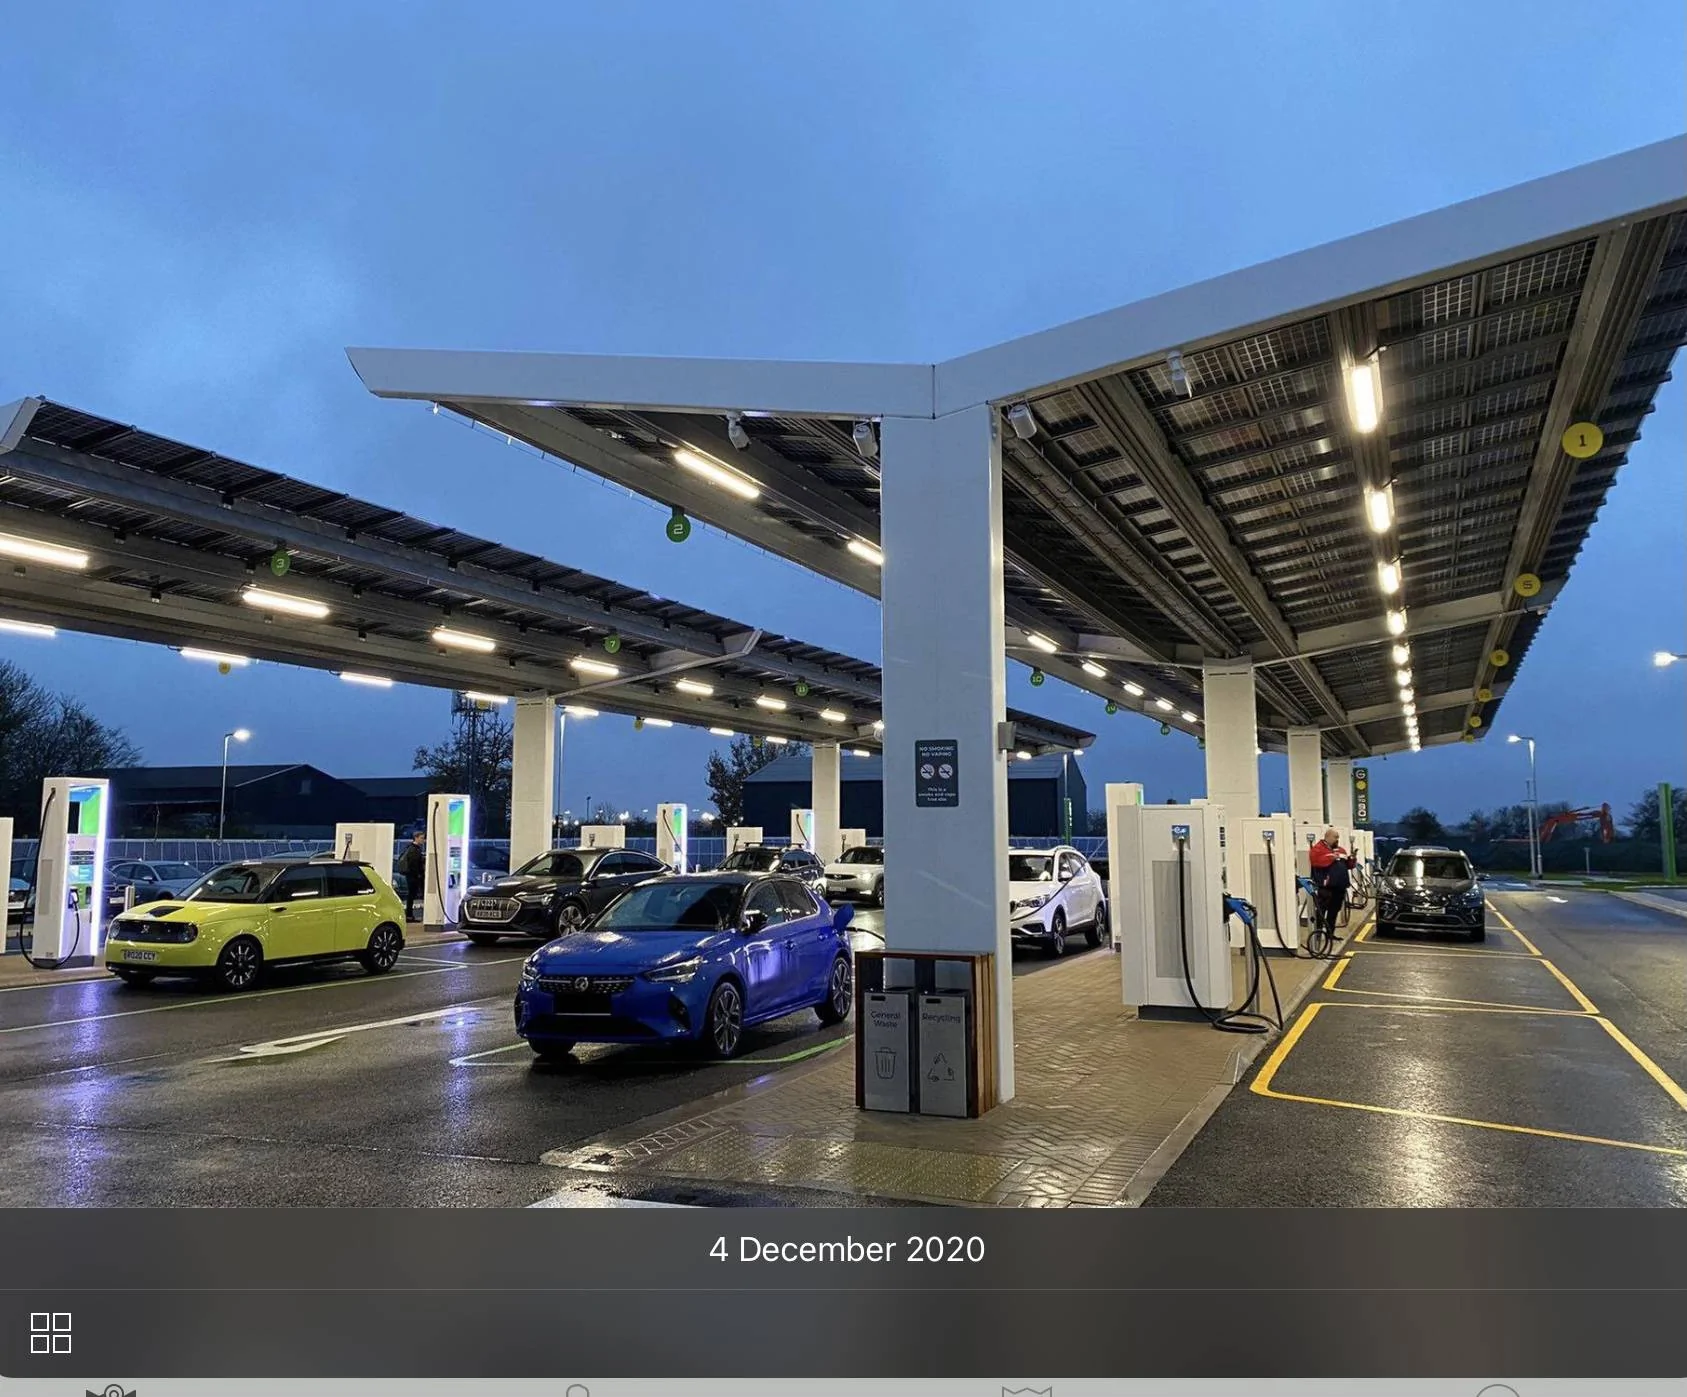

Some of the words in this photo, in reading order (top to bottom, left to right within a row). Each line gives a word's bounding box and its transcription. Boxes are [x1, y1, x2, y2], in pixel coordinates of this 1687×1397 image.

[1579, 434, 1587, 448] 1
[673, 523, 684, 535] 2
[276, 558, 285, 569] 3
[871, 1011, 901, 1019] General
[922, 1012, 961, 1024] Recycling
[873, 1019, 898, 1028] Waste
